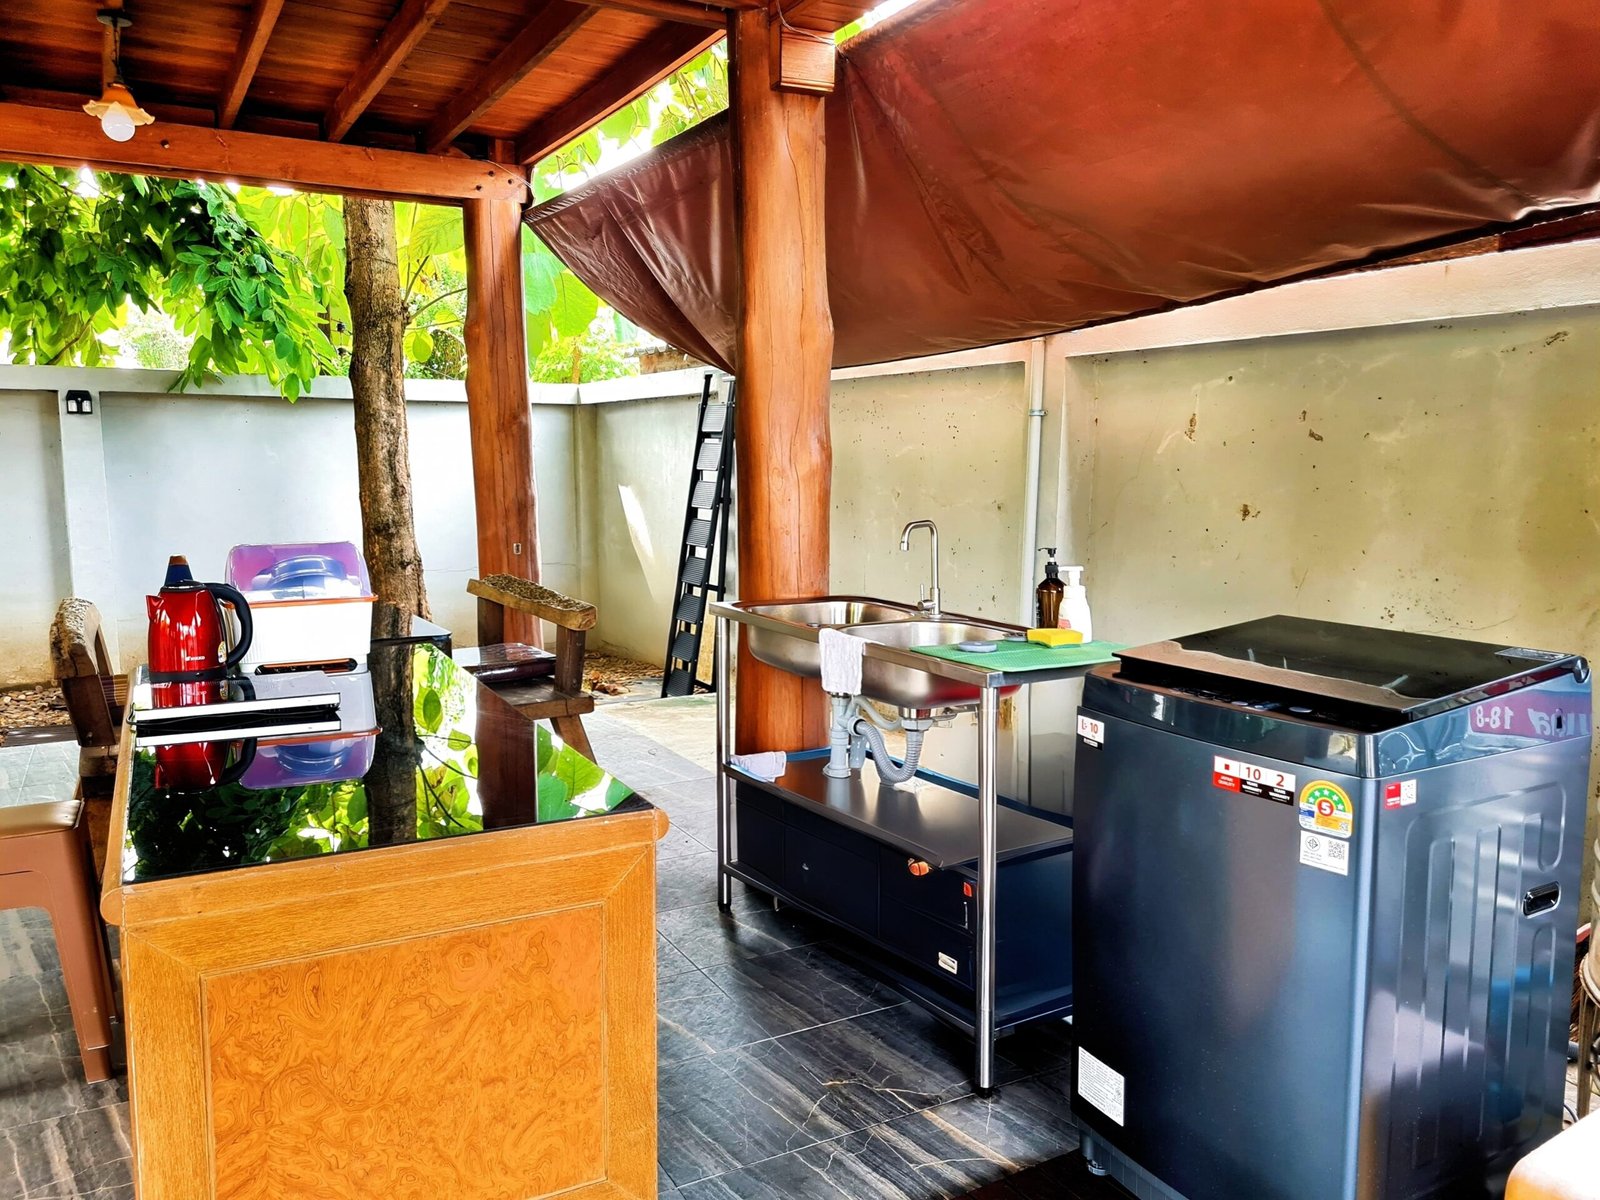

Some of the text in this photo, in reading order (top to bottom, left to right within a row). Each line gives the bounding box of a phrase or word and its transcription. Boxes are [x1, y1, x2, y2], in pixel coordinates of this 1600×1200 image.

[1090, 722, 1099, 734] 10
[1245, 767, 1262, 780] 10
[1275, 774, 1285, 787] 2
[1320, 801, 1331, 815] 5
